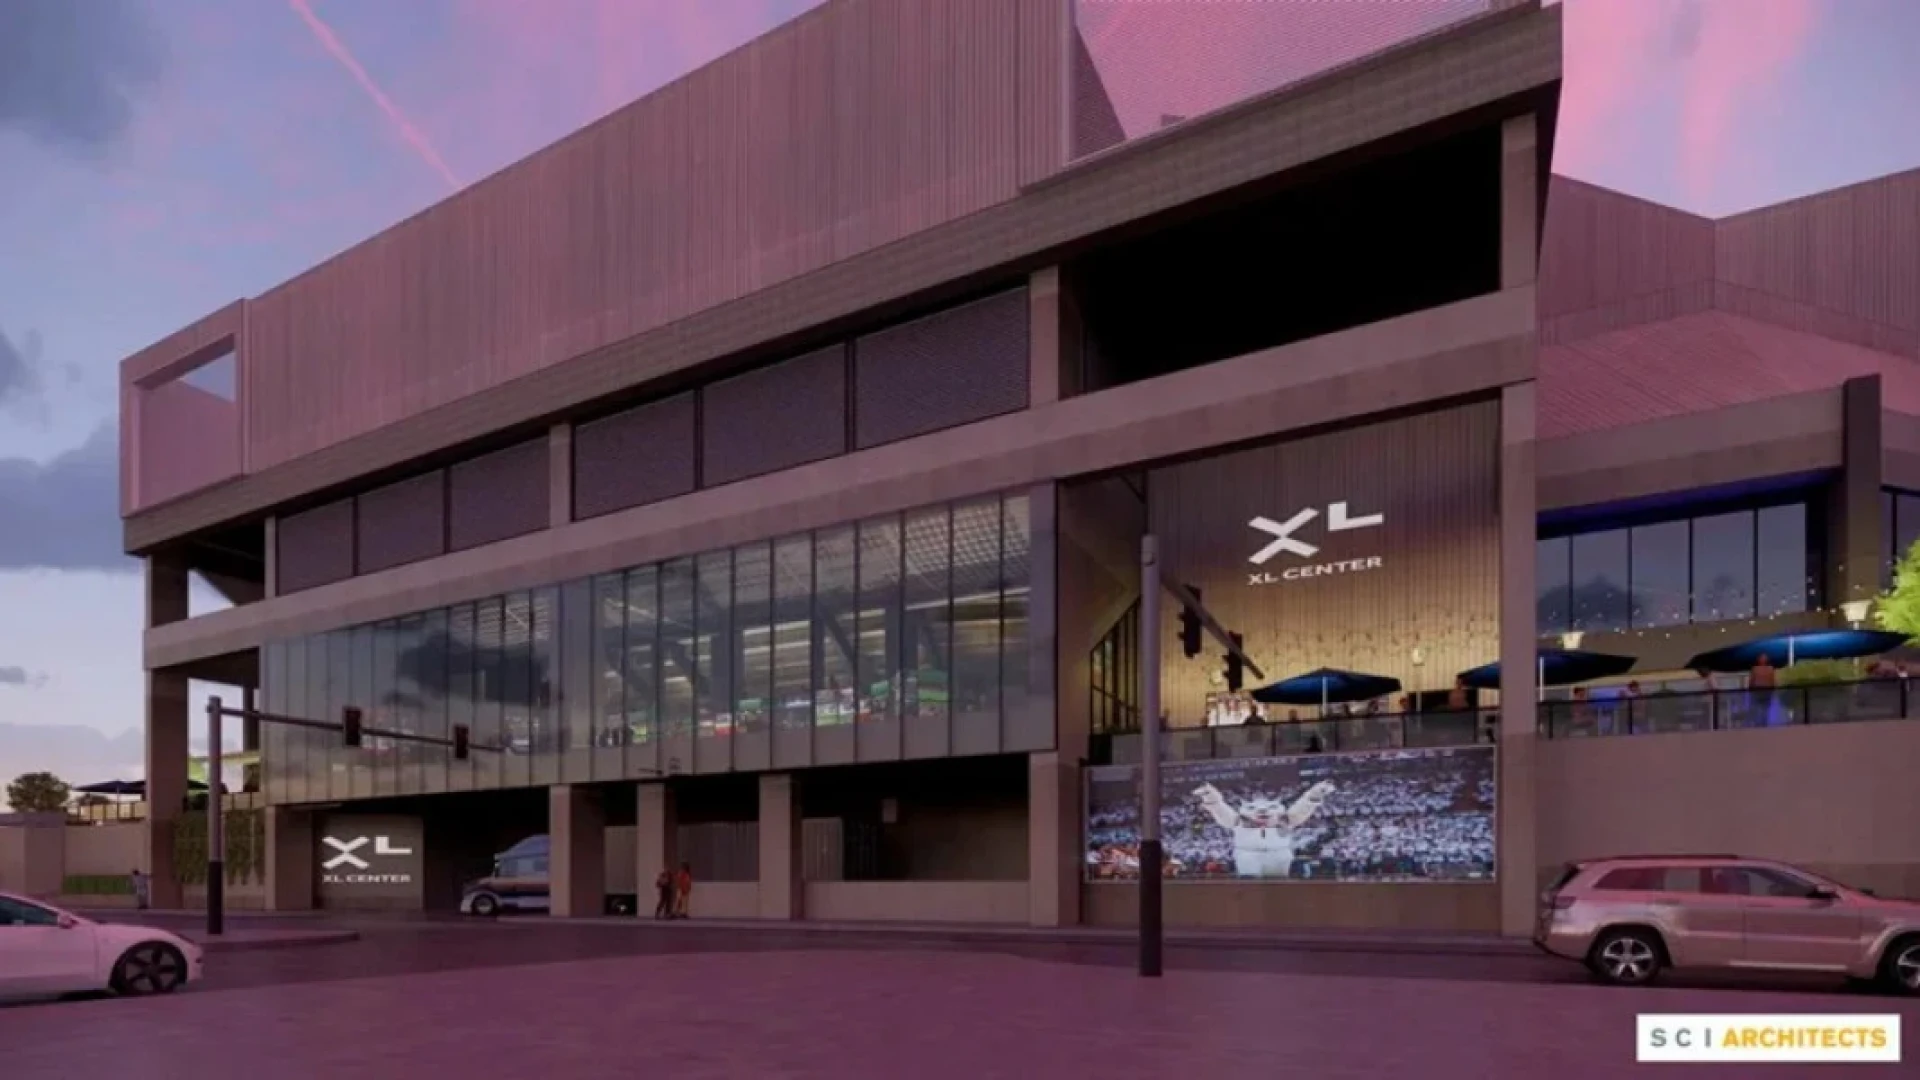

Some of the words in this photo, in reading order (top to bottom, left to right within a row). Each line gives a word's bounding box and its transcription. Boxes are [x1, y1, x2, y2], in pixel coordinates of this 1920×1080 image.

[1249, 501, 1384, 564] XL
[1247, 572, 1279, 585] XL
[1282, 555, 1383, 580] CENTER
[322, 836, 412, 869] XL
[323, 874, 345, 883] XL
[346, 874, 411, 883] CENTER
